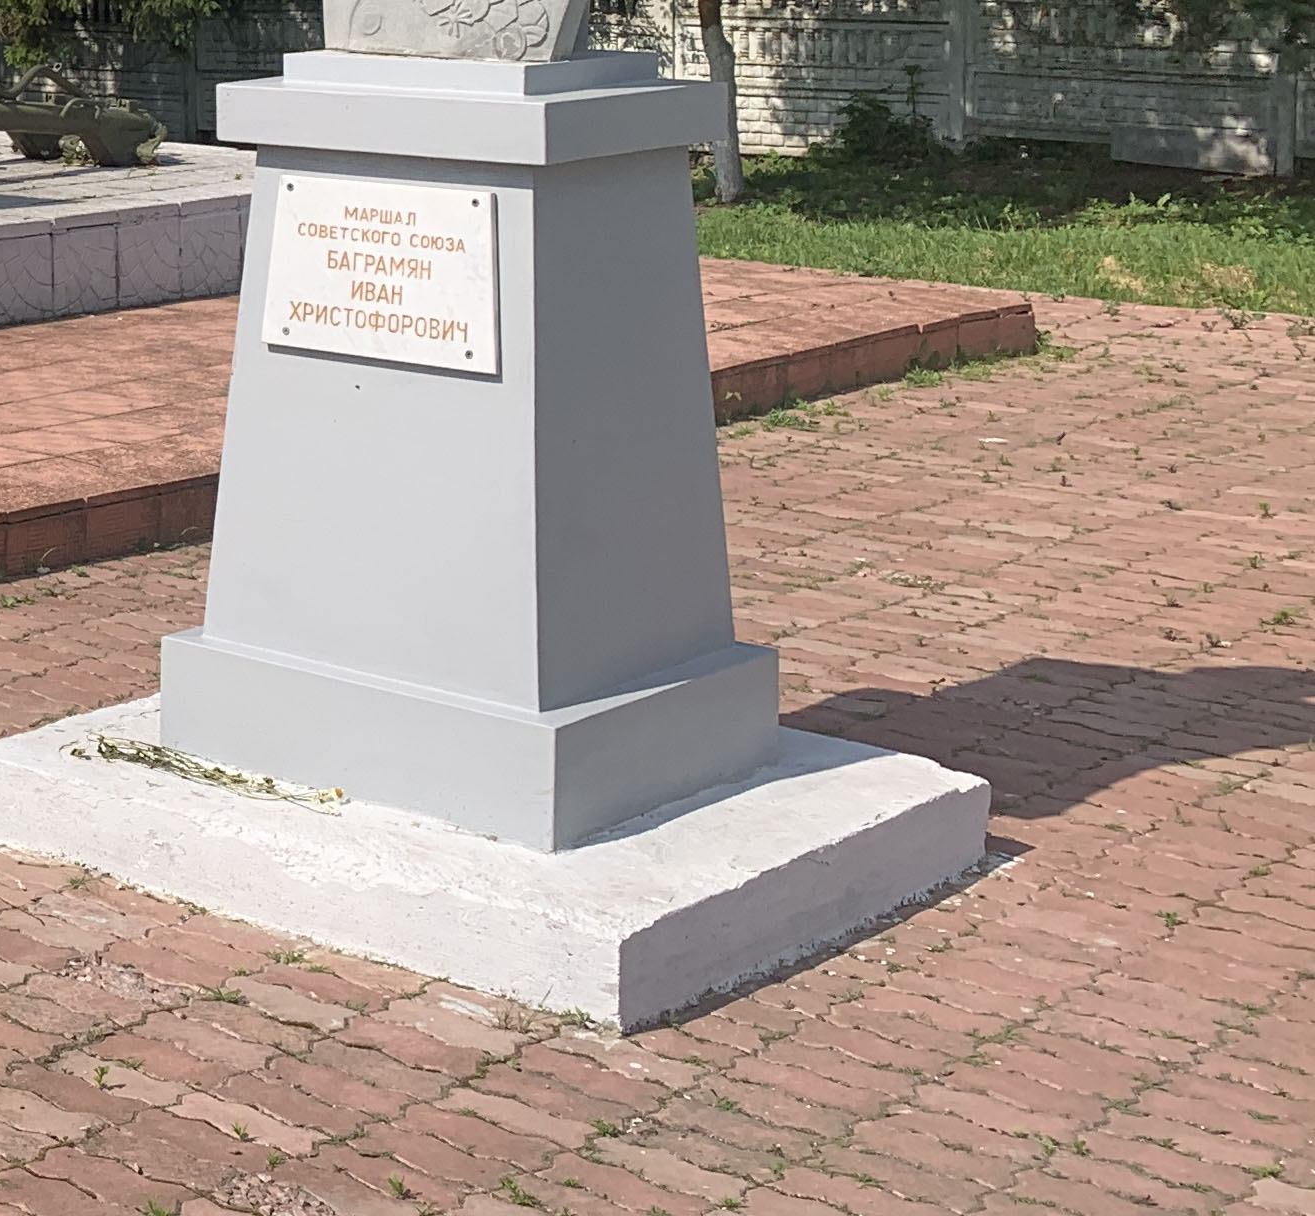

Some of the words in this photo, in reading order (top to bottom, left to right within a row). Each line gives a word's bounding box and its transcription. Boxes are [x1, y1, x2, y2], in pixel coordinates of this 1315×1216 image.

[344, 206, 417, 227] МАРШАЛ
[297, 222, 401, 247] СОВЕТСКОГО
[409, 233, 466, 254] СОЮЗА
[327, 250, 432, 280] БАГРАМЯН
[350, 280, 403, 306] ИВАН
[288, 300, 469, 343] ХРИСТОФОРОВИЧ
